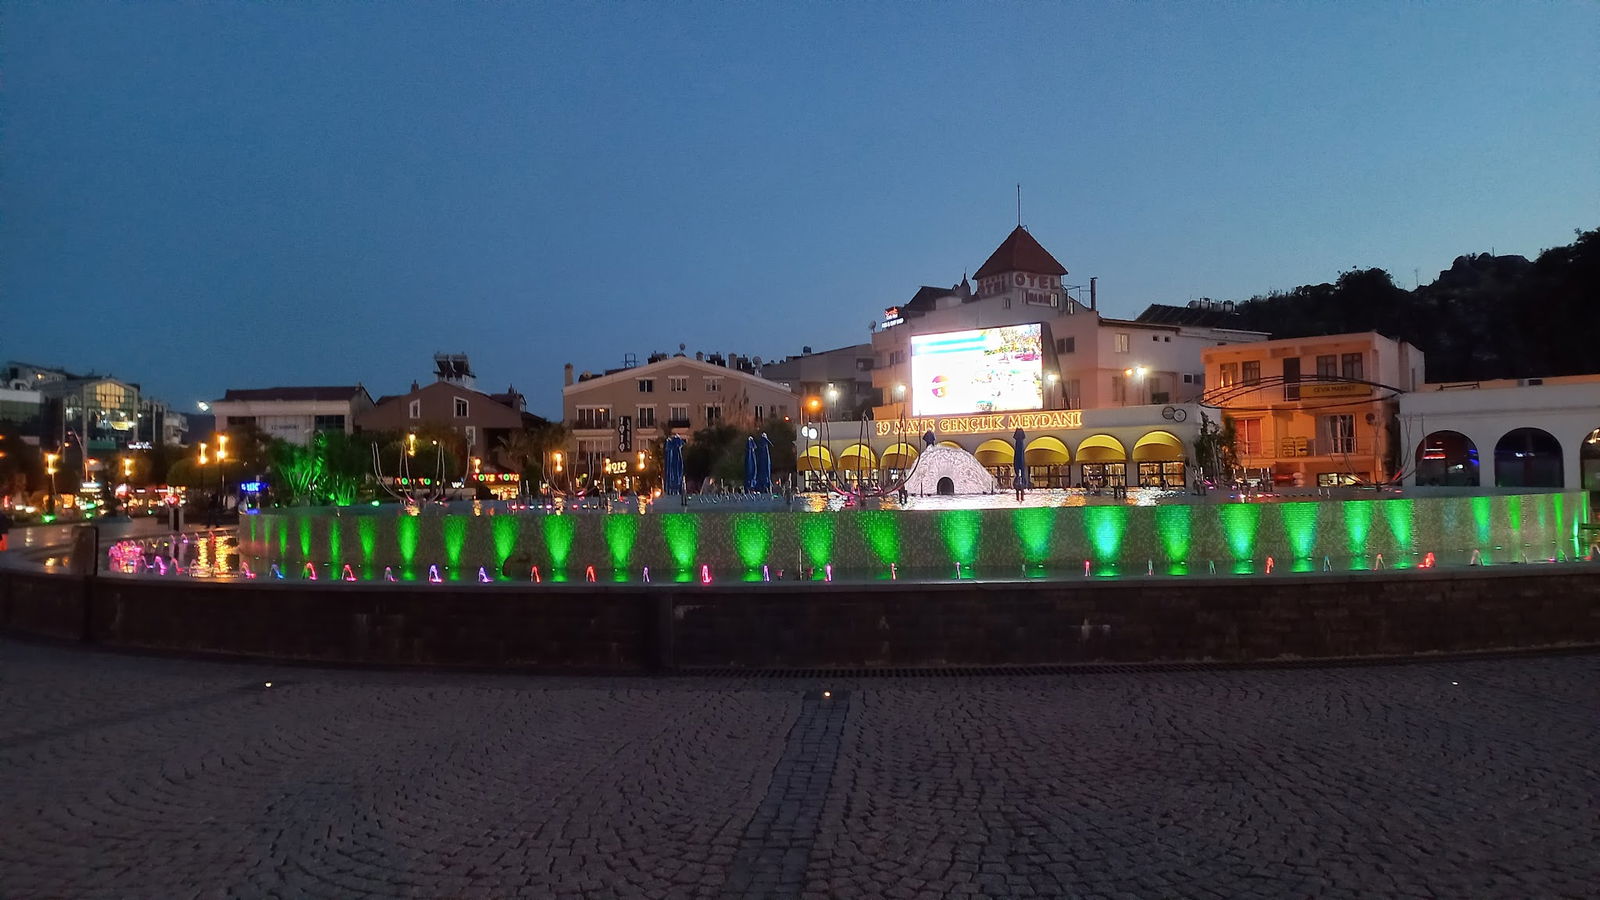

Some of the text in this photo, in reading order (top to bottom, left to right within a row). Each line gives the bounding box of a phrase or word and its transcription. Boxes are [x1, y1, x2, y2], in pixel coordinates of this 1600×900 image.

[1015, 272, 1060, 289] OTEL
[876, 411, 1082, 436] 19 MAYIS GENÇLİK MEYDANI
[473, 474, 496, 482] TOYS
